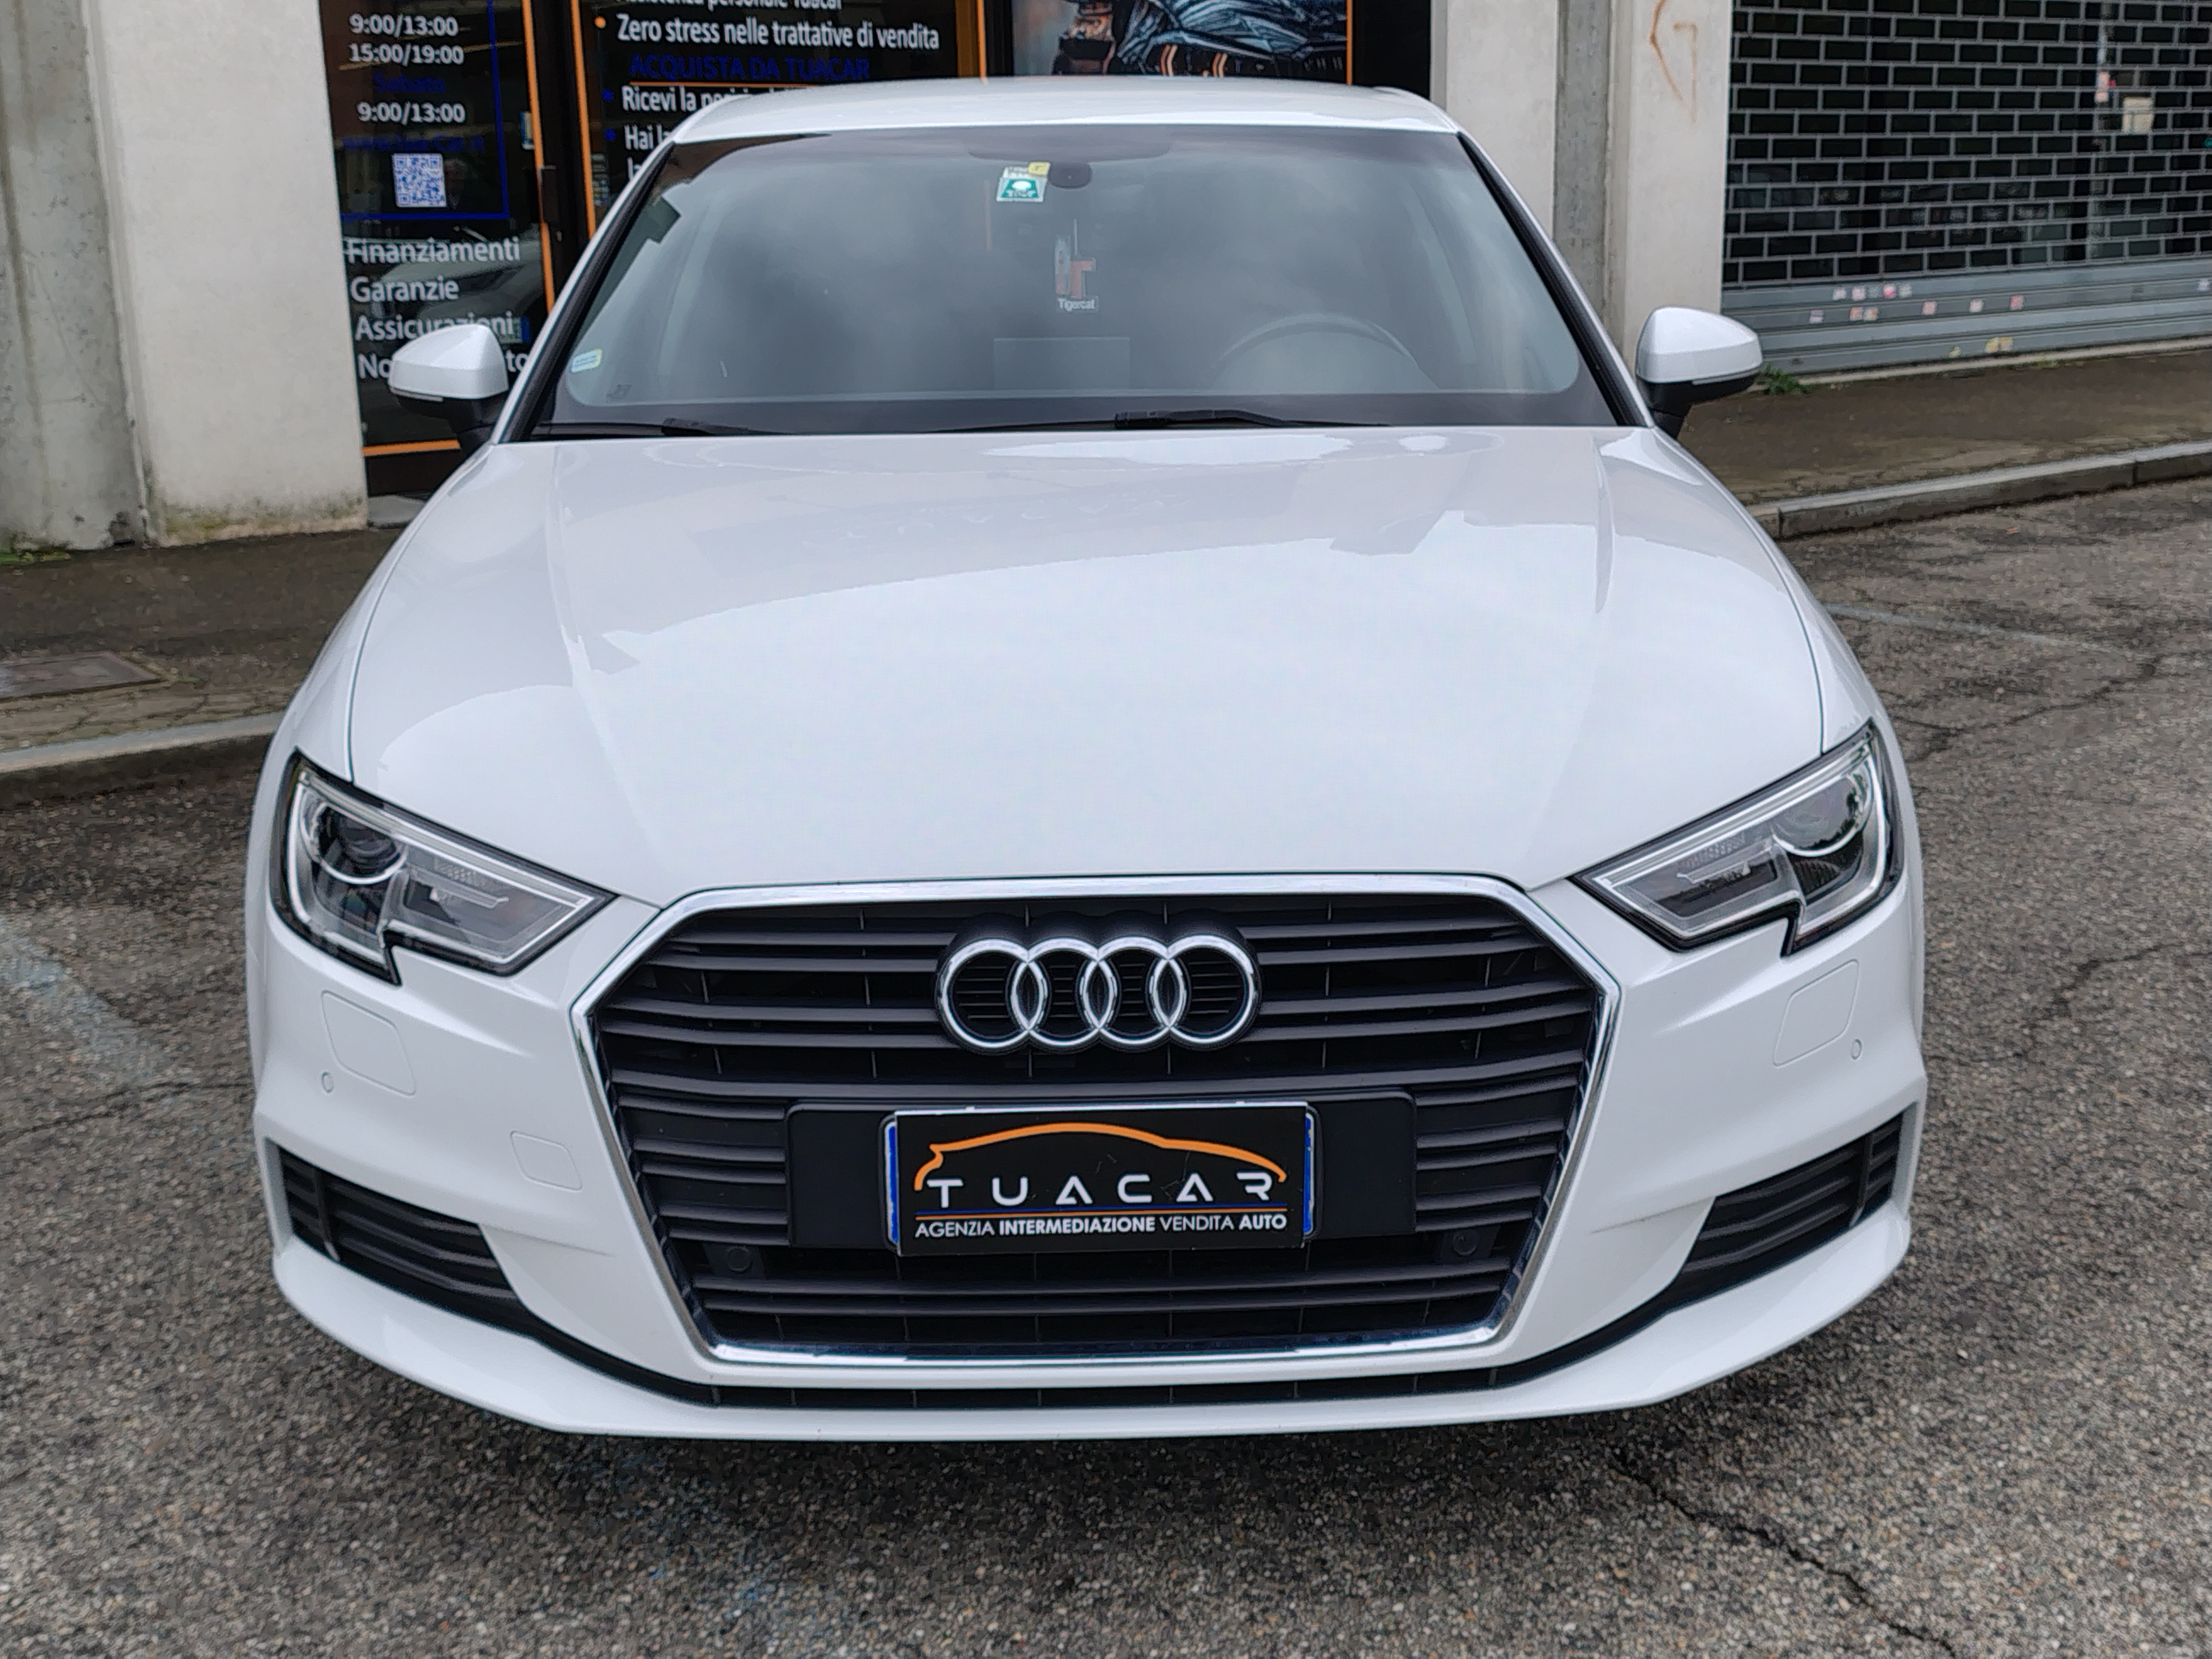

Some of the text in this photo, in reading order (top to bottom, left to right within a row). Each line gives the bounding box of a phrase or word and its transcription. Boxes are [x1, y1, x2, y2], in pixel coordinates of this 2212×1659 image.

[349, 14, 458, 38] 9:00/13:00
[616, 12, 940, 50] Zero stress nelle trattative di vendita
[348, 43, 464, 66] 15:00/19:00
[629, 54, 869, 81] ACQUISTA DA TUACAR
[622, 85, 676, 111] Ricevi
[679, 85, 697, 111] la
[357, 102, 466, 125] 9:00/13:00
[624, 124, 653, 150] Hai
[347, 237, 520, 264] Finanziamenti
[350, 275, 458, 302] Garanzie
[355, 311, 513, 341] Assicurni
[926, 1170, 1273, 1209] TUACAR
[915, 1213, 1287, 1238] AGENZIA INTERMEDIAZIONE VENDITA AUTO
